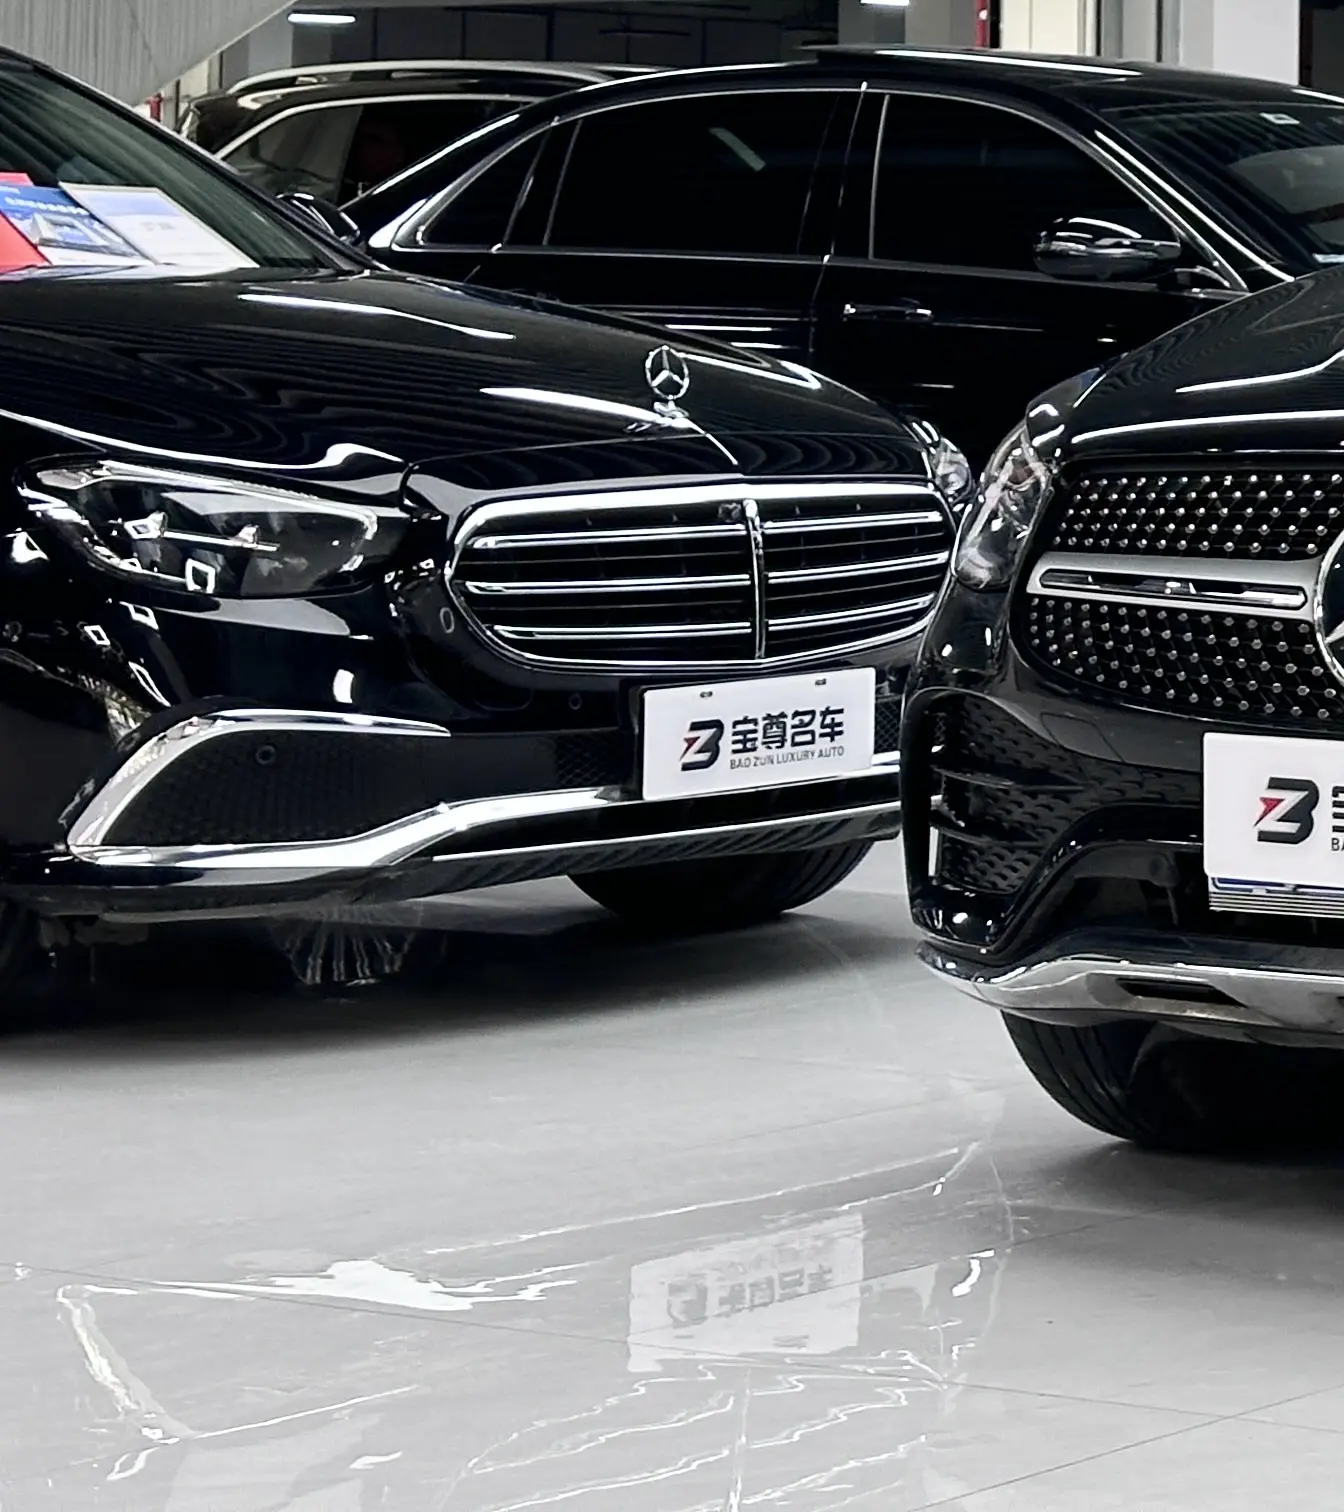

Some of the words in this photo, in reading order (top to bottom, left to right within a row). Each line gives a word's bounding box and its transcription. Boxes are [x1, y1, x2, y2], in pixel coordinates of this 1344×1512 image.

[732, 706, 844, 754] 宝尊名车
[730, 756, 752, 770] BAO
[753, 754, 774, 768] ZUN
[777, 749, 815, 765] LUXURY
[818, 745, 845, 759] AUTO
